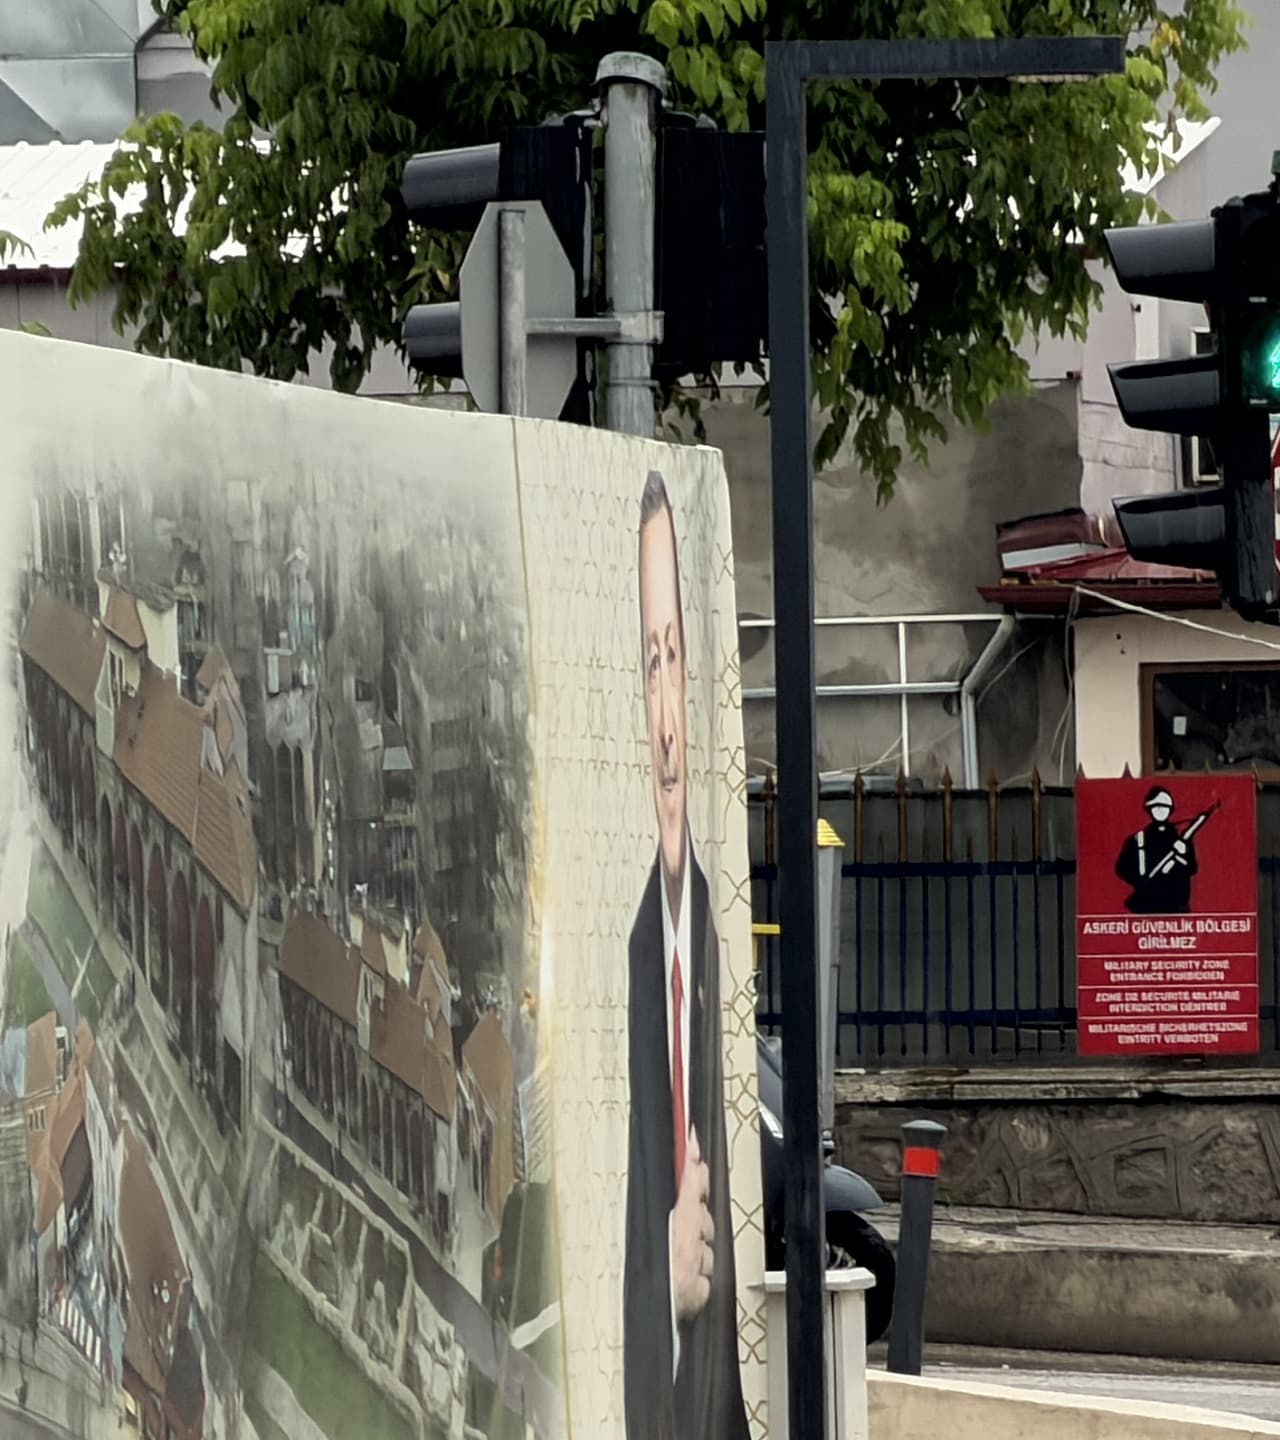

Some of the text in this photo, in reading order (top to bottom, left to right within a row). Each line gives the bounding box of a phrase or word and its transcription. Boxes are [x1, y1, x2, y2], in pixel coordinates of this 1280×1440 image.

[1083, 917, 1251, 934] ASKERİ GÜVENLİK BÖLGESİ
[1138, 935, 1197, 949] GİRİLMEZ
